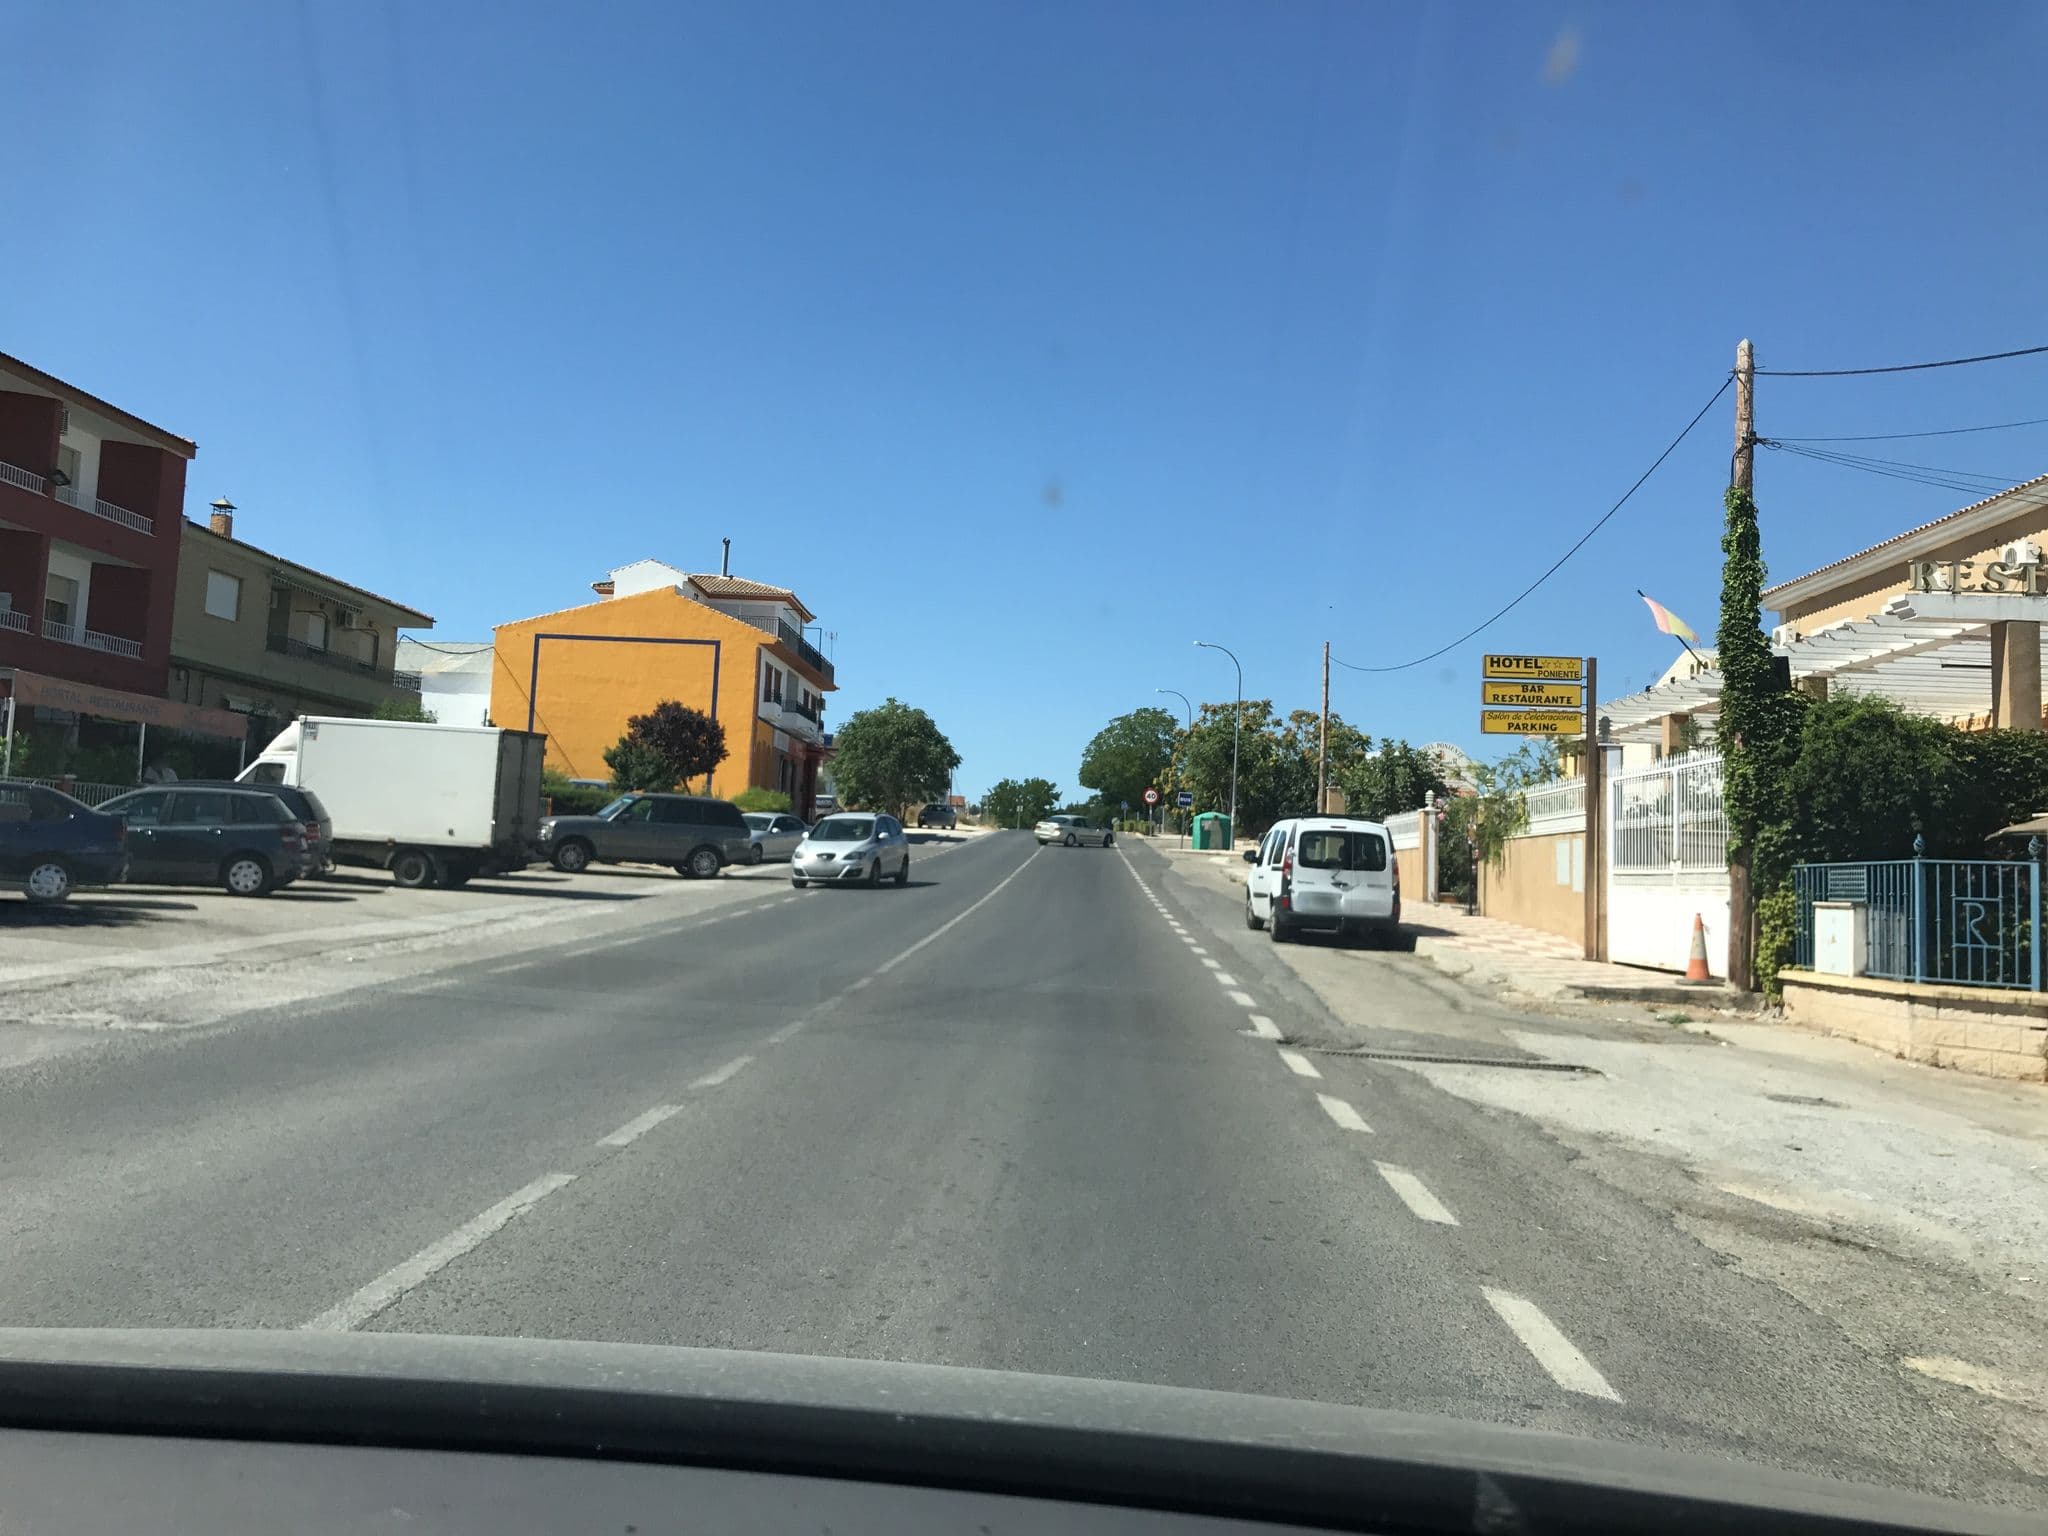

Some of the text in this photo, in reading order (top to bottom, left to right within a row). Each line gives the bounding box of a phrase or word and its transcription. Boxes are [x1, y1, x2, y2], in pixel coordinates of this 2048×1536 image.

[1490, 657, 1543, 669] HOTEL
[1537, 669, 1580, 679] PONIENTE
[1521, 684, 1545, 693] BAR
[1492, 693, 1573, 705] RESTAURANTE
[1512, 712, 1522, 721] de
[1523, 712, 1578, 722] Celebraciones
[1507, 722, 1558, 732] PARKING
